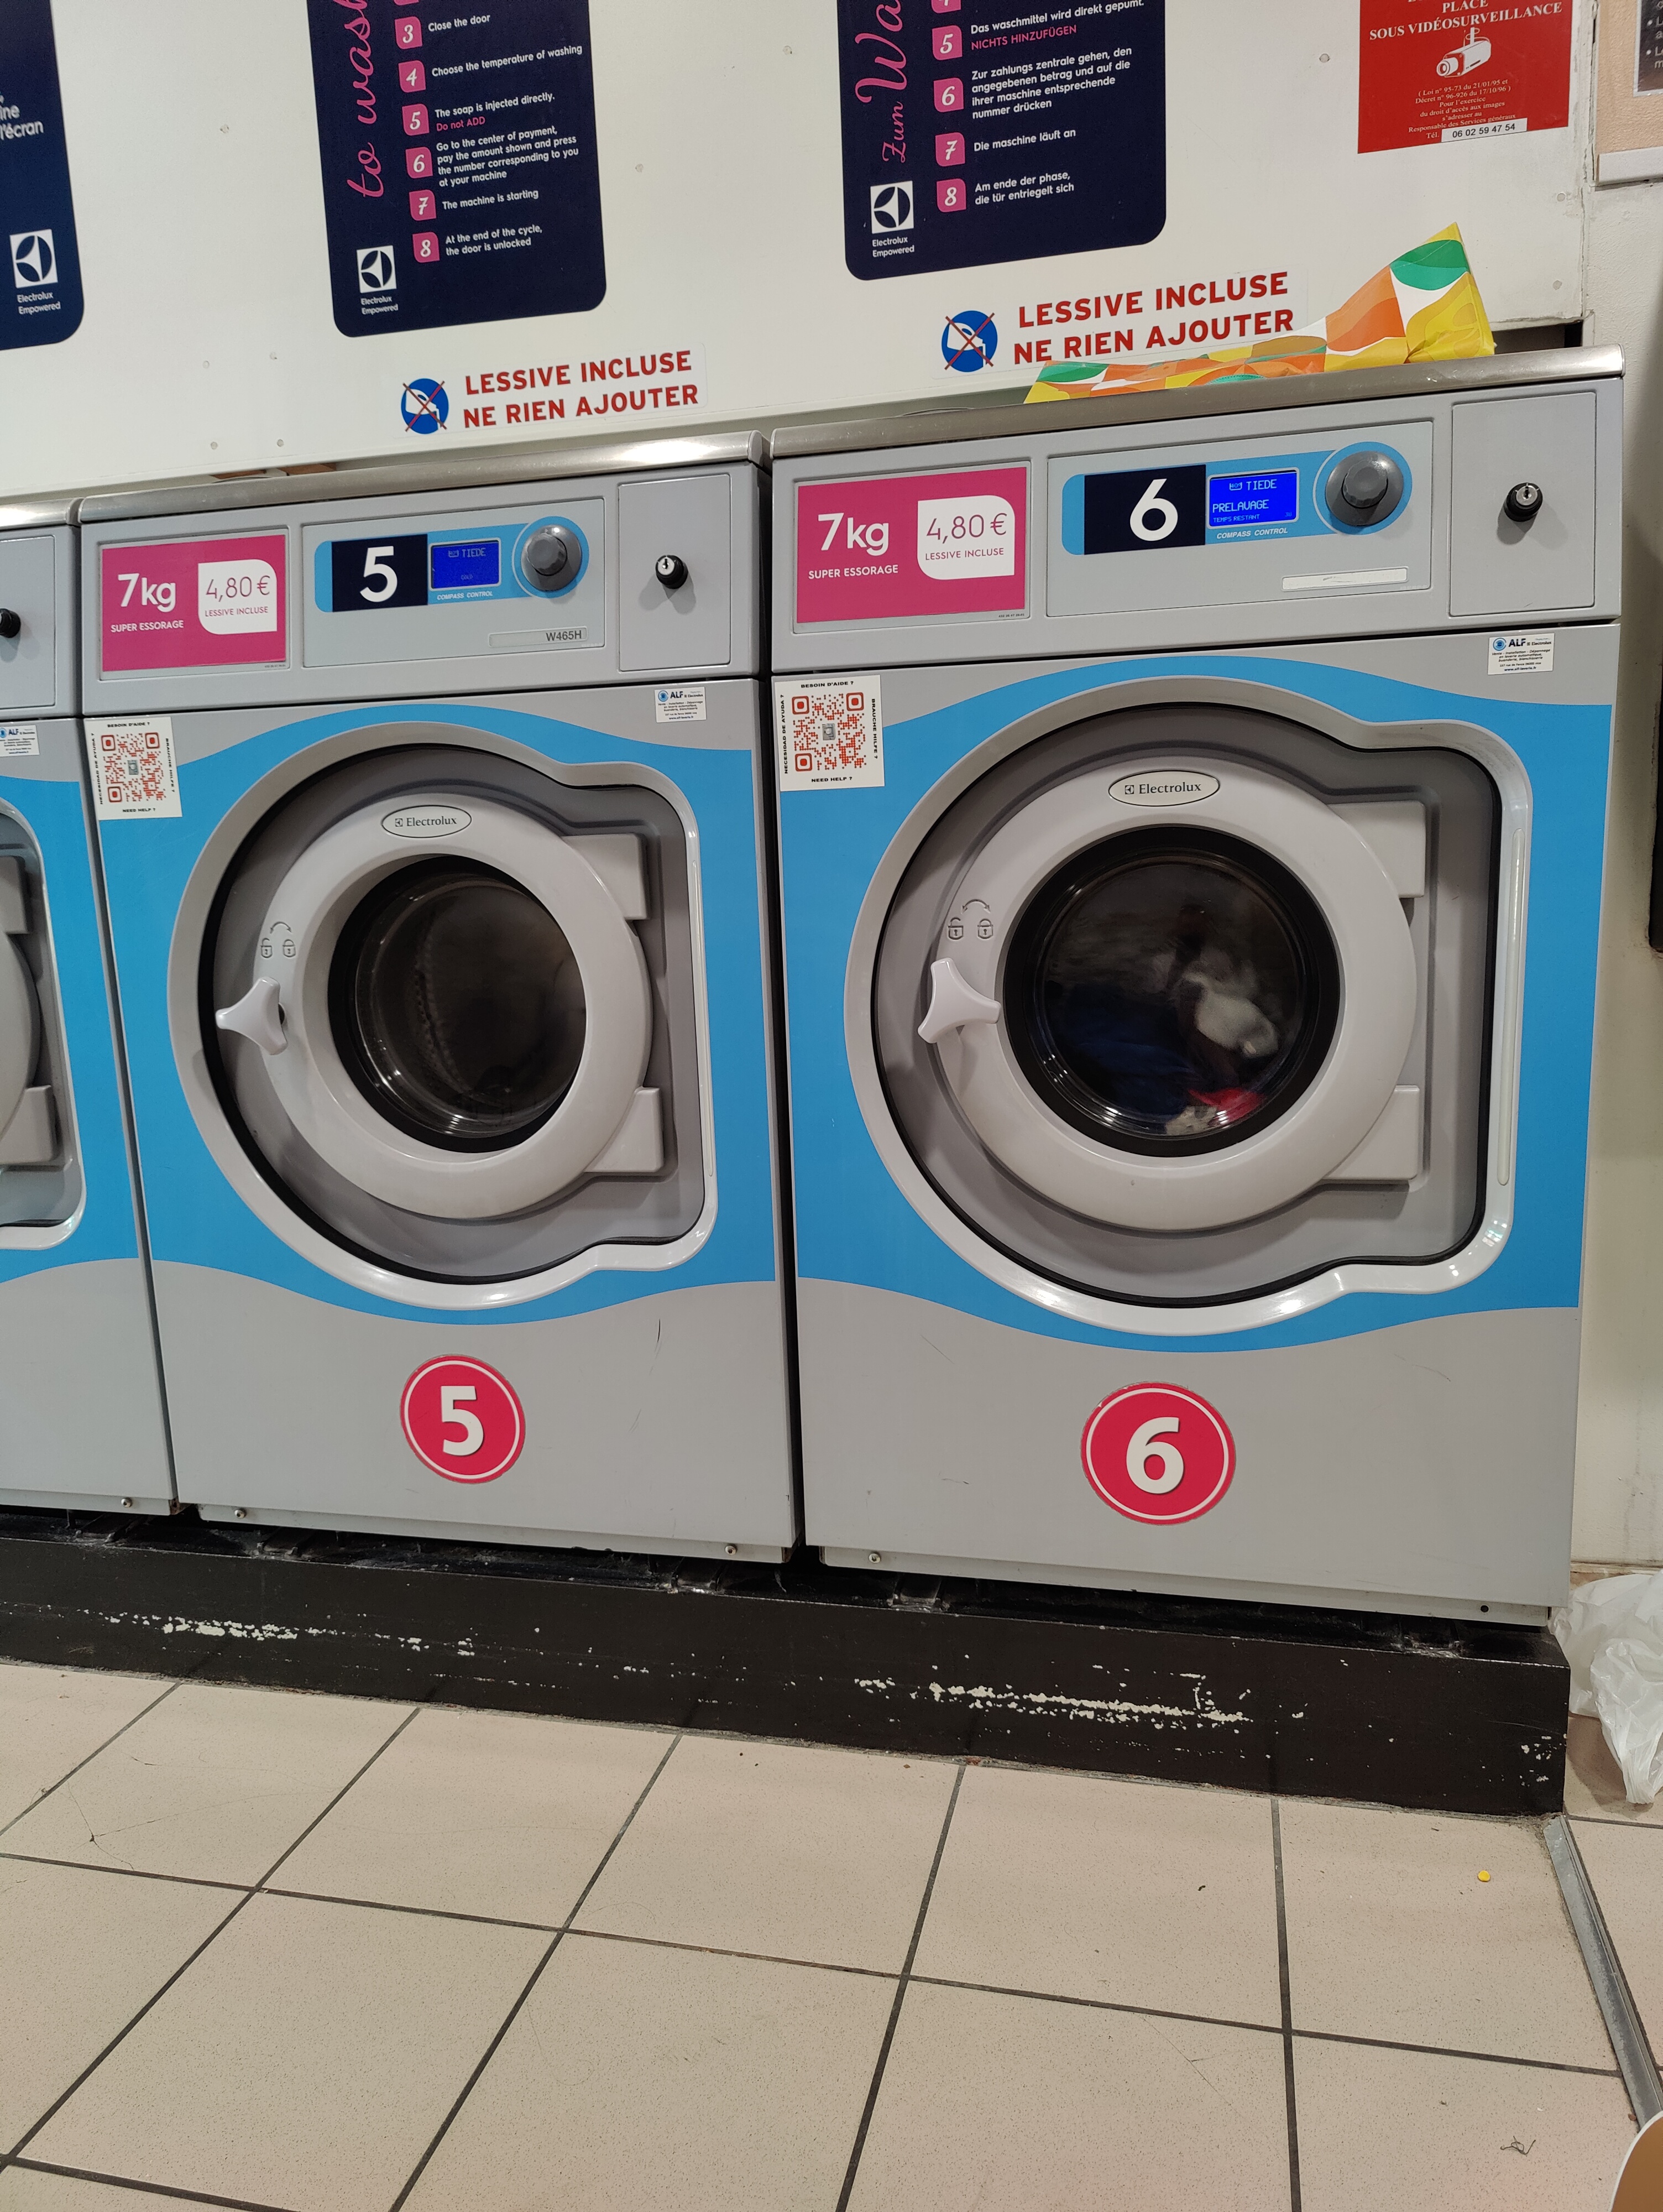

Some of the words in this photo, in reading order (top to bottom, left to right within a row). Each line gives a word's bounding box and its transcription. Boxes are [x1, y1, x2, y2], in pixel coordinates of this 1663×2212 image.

[1442, 0, 1488, 13] PLACE
[428, 22, 452, 32] Close
[454, 18, 468, 28] the
[470, 14, 490, 25] door
[971, 24, 990, 34] Das
[991, 12, 1048, 30] waschmittel
[1050, 8, 1071, 21] wird
[1074, 3, 1102, 17] direkt
[1369, 25, 1405, 40] SOUS
[1409, 2, 1562, 34] VIDÉOSURVEILLANCE
[402, 25, 414, 43] 3
[971, 36, 1008, 50] NICHTS
[1011, 24, 1076, 44] HINZUFÜGEN
[940, 34, 953, 54] 5
[431, 65, 464, 77] Choose
[465, 62, 479, 71] the
[481, 54, 534, 69] temperature
[536, 49, 545, 60] of
[547, 45, 583, 58] washing
[971, 70, 988, 80] Zur
[991, 64, 1033, 77] zahlungs
[1036, 55, 1075, 70] zentrale
[1078, 51, 1110, 65] gehen,
[1113, 47, 1132, 58] den
[406, 69, 417, 86] 4
[1444, 85, 1462, 93] 95-73
[1472, 79, 1500, 89] 21/01/95
[942, 86, 955, 106] 6
[1479, 86, 1506, 95] 17/10/96
[435, 109, 451, 118] The
[452, 106, 474, 116] soap
[475, 103, 483, 112] is
[485, 96, 519, 112] injected
[521, 92, 555, 105] directly.
[1445, 106, 1468, 114] d'accès
[1456, 97, 1486, 106] l'exercice
[410, 112, 421, 129] 5
[1409, 123, 1446, 133] Responsable
[1461, 117, 1486, 126] Services
[1488, 114, 1516, 123] généraux
[1442, 113, 1473, 121] s'adresser
[436, 142, 449, 152] Go
[451, 140, 460, 149] to
[462, 138, 476, 148] the
[478, 134, 505, 145] center
[507, 131, 516, 141] of
[518, 126, 558, 141] payment,
[882, 102, 906, 163] Zum
[1452, 130, 1463, 138] 06
[1465, 128, 1476, 137] 02
[1478, 127, 1489, 135] 59
[1491, 124, 1502, 133] 47
[1505, 123, 1515, 131] 54
[974, 141, 990, 152] Die
[992, 135, 1037, 149] maschine
[1039, 130, 1061, 142] läuft
[1063, 129, 1076, 138] an
[945, 141, 957, 160] 7
[347, 142, 384, 197] to
[414, 155, 424, 173] 6
[975, 182, 991, 192] Am
[993, 178, 1017, 190] ende
[1019, 176, 1037, 186] der
[1039, 172, 1070, 185] phase,
[945, 188, 956, 206] 8
[975, 195, 990, 205] die
[992, 192, 1006, 202] tür
[1008, 185, 1053, 200] entriegelt
[1055, 182, 1074, 194] sich
[872, 236, 908, 247] Electrolux
[872, 244, 915, 258] Empowered
[17, 291, 54, 303] Electrolux
[1019, 290, 1143, 328] LESSIVE
[1156, 271, 1288, 311] INCLUSE
[19, 302, 61, 315] Empowered
[1014, 339, 1055, 365] NE
[1064, 328, 1133, 359] RIEN
[1146, 309, 1293, 349] AJOUTER
[466, 364, 571, 395] LESSIVE
[581, 350, 692, 383] INCLUSE
[463, 406, 496, 429] NE
[506, 399, 565, 424] RIEN
[576, 384, 698, 417] AJOUTER
[1246, 479, 1277, 491] TIEDE
[1129, 479, 1178, 541] 6
[1212, 499, 1269, 513] PRELAVAGE
[1216, 530, 1251, 539] COMPASS
[1253, 527, 1288, 536] CONTROL
[461, 547, 486, 558] TIEDE
[925, 550, 961, 561] LESSIVE
[965, 547, 1004, 558] INCLUSE
[359, 546, 398, 602] 5
[808, 568, 840, 580] SUPER
[844, 564, 898, 577] ESSORAGE
[205, 608, 234, 617] LESSIVE
[237, 606, 268, 615] INCLUSE
[111, 623, 137, 633] SUPER
[139, 620, 184, 631] ESSORAGE
[546, 630, 582, 641] W465H
[1508, 638, 1526, 647] ALF
[782, 725, 786, 734] DE
[1139, 782, 1201, 794] Electrolux
[406, 816, 457, 826] Electrolux
[441, 1385, 484, 1456] 5
[1126, 1417, 1185, 1494] 6
